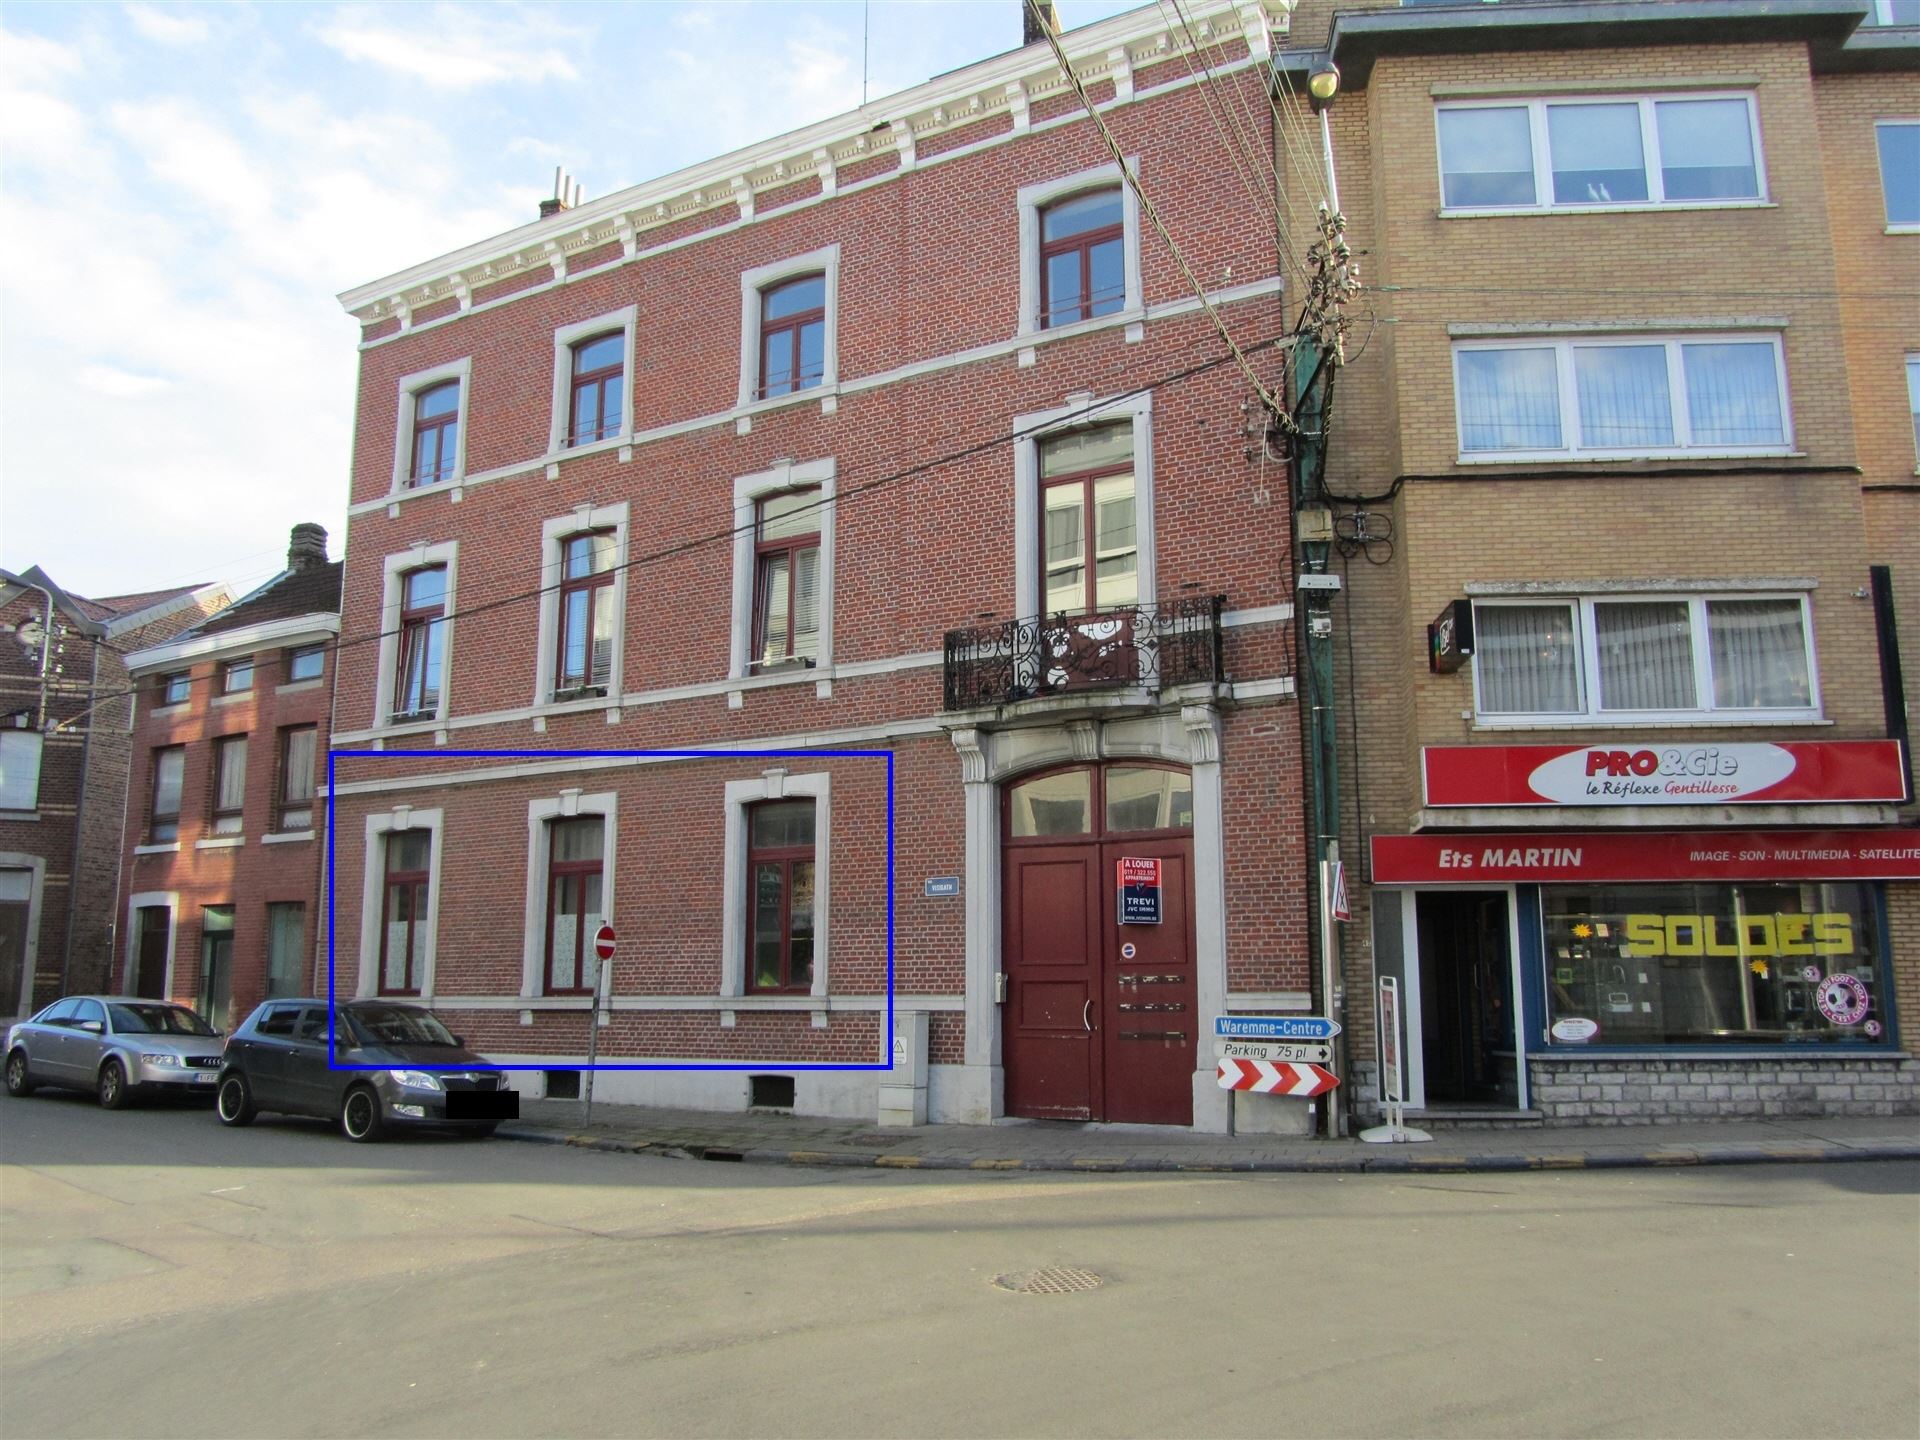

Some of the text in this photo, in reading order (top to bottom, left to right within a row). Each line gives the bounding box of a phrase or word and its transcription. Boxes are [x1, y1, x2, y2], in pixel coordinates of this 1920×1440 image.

[1586, 748, 1738, 777] PRO&Cie
[1586, 780, 1739, 798] le Réflexe Gentillesse
[1439, 848, 1582, 868] Ets MARTIN
[1690, 850, 1730, 861] IMAGE
[1738, 850, 1766, 861] SON
[1774, 850, 1850, 861] MULTIMEDIA
[1125, 860, 1155, 869] A LOUER
[1127, 897, 1155, 906] TREVI
[1627, 913, 1854, 957] SOLDES
[1830, 975, 1849, 984] FOOT
[1220, 1019, 1323, 1035] Waremme-Centre
[1224, 1044, 1307, 1060] Parking 75 pl
